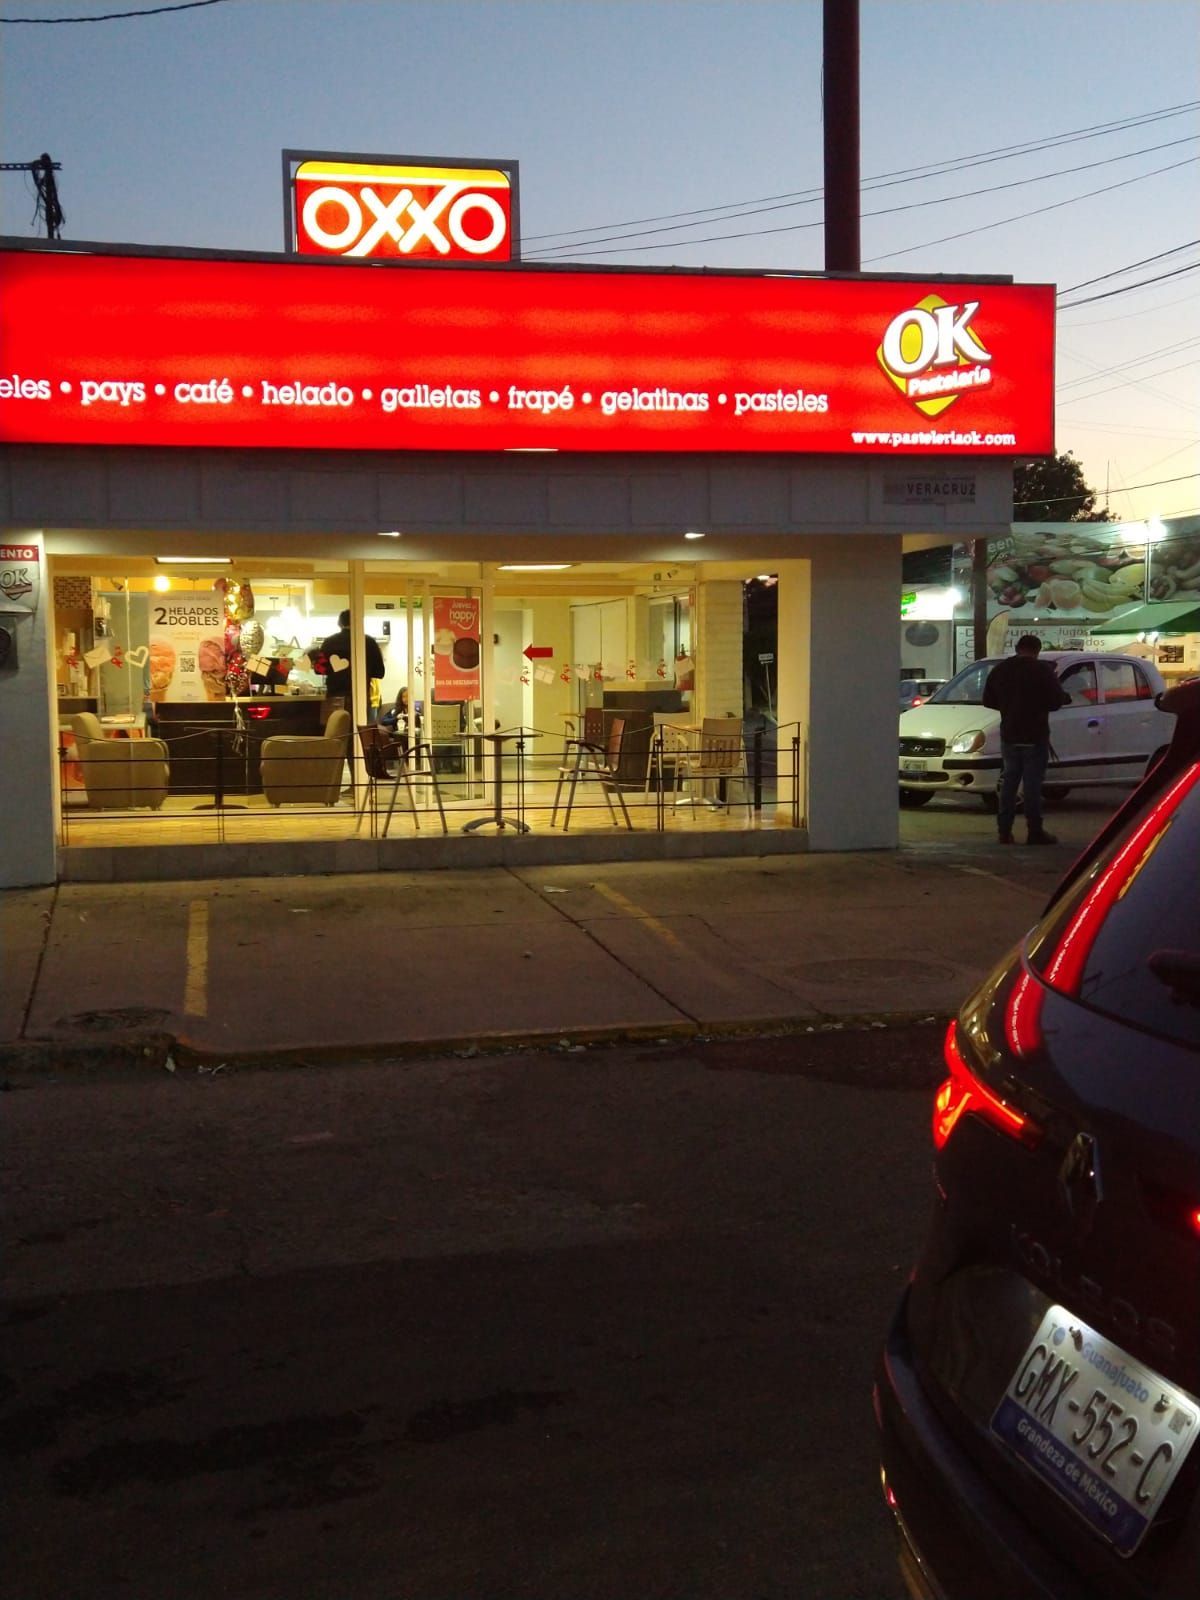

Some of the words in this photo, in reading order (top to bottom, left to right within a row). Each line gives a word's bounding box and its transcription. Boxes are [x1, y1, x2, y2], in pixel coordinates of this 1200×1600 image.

[302, 186, 507, 257] OXXO
[883, 302, 992, 374] OK
[0, 375, 52, 400] eles
[79, 380, 147, 408] pays
[174, 378, 235, 405] café
[261, 381, 354, 407] helado
[380, 385, 482, 413] galletas
[507, 385, 575, 414] frapé
[600, 388, 710, 416] gelatinas
[734, 390, 829, 416] pasteles
[851, 430, 1017, 448] www.pasteleriaok.com
[906, 482, 977, 496] VERACRUZ
[0, 567, 32, 588] OK
[154, 607, 168, 625] 2
[168, 607, 218, 615] HELADOS
[168, 616, 220, 626] DOBLES
[1081, 1342, 1149, 1403] Guanajuato
[1014, 1344, 1174, 1504] GMX-552-C
[1017, 1418, 1065, 1468] Grandeza
[1064, 1461, 1082, 1482] de
[1079, 1472, 1118, 1516] México
